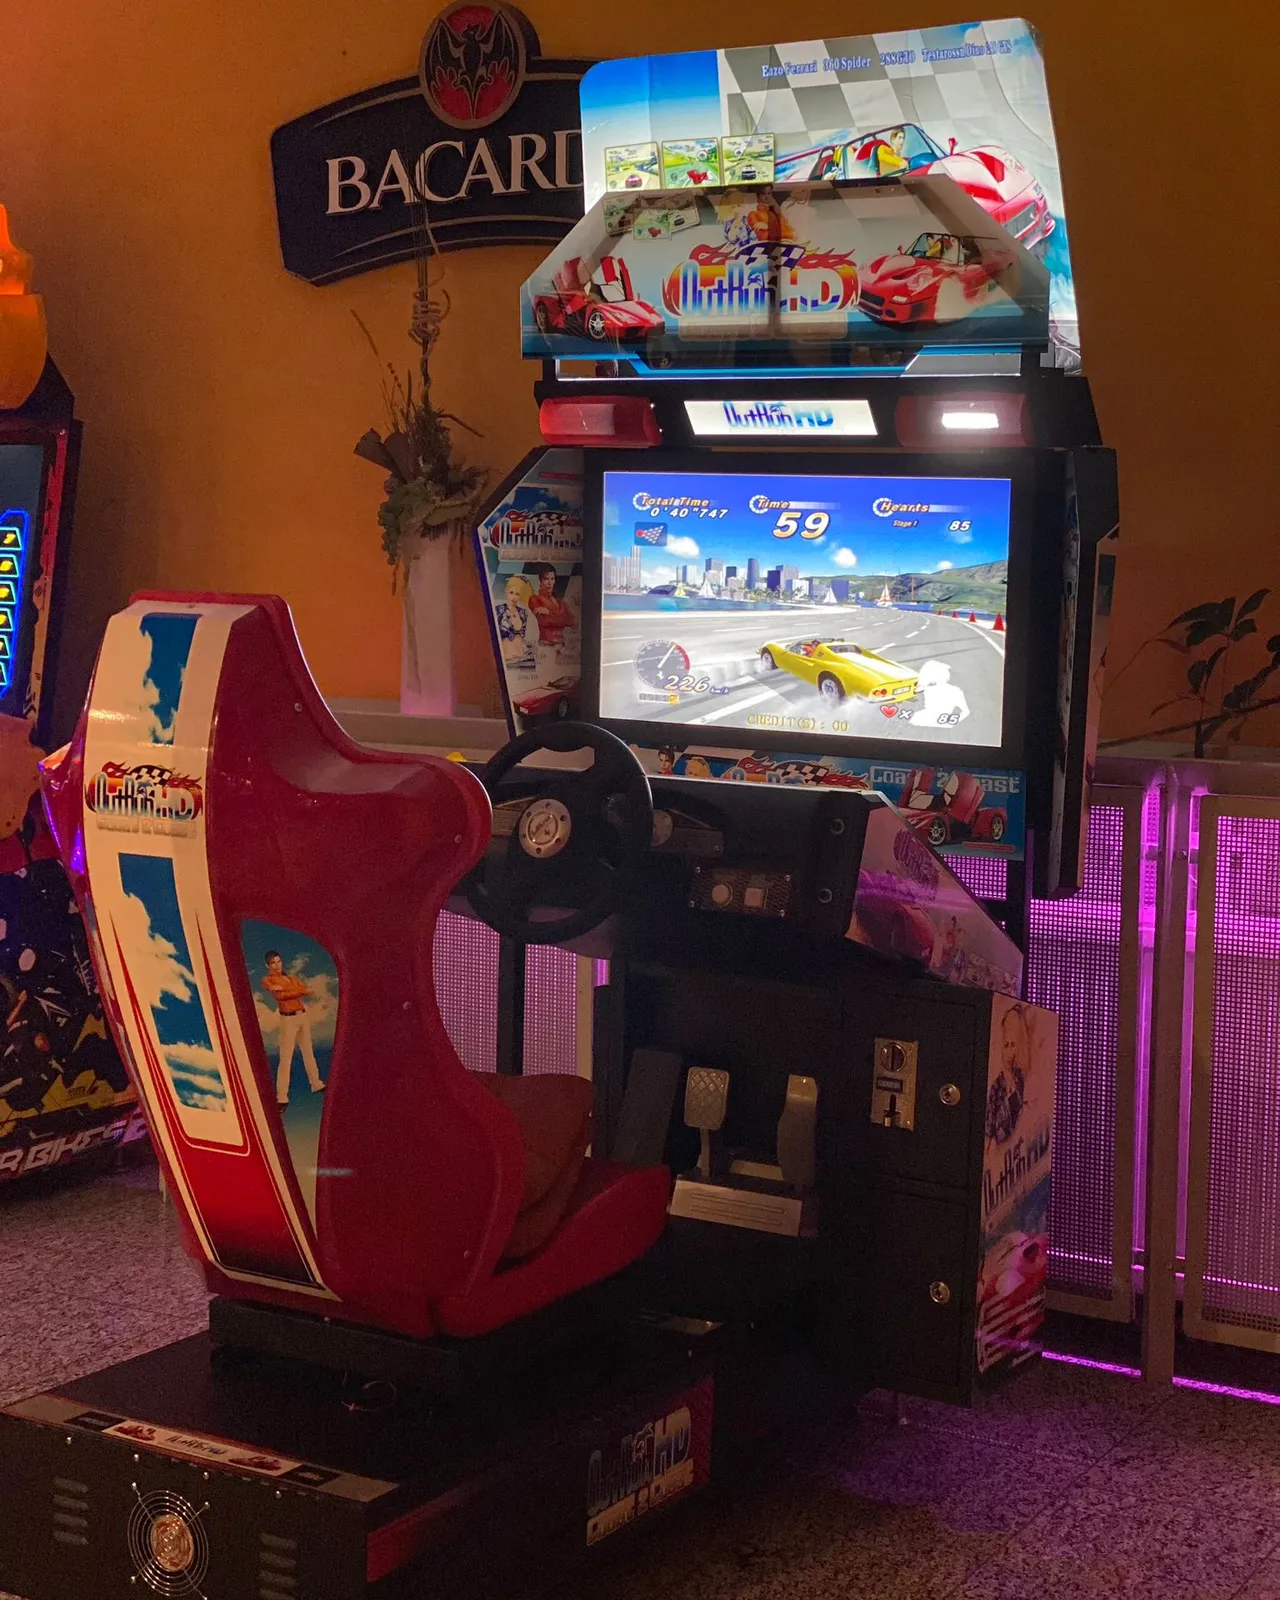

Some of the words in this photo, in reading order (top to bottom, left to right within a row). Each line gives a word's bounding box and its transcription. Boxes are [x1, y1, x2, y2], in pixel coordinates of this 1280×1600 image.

[841, 57, 871, 71] Spider
[723, 400, 794, 428] OutRun
[680, 497, 710, 508] Time
[757, 498, 790, 510] Time
[881, 502, 929, 512] Hearts
[772, 512, 830, 540] 59
[948, 520, 972, 532] 85
[664, 674, 711, 693] 226
[937, 713, 961, 725] 85
